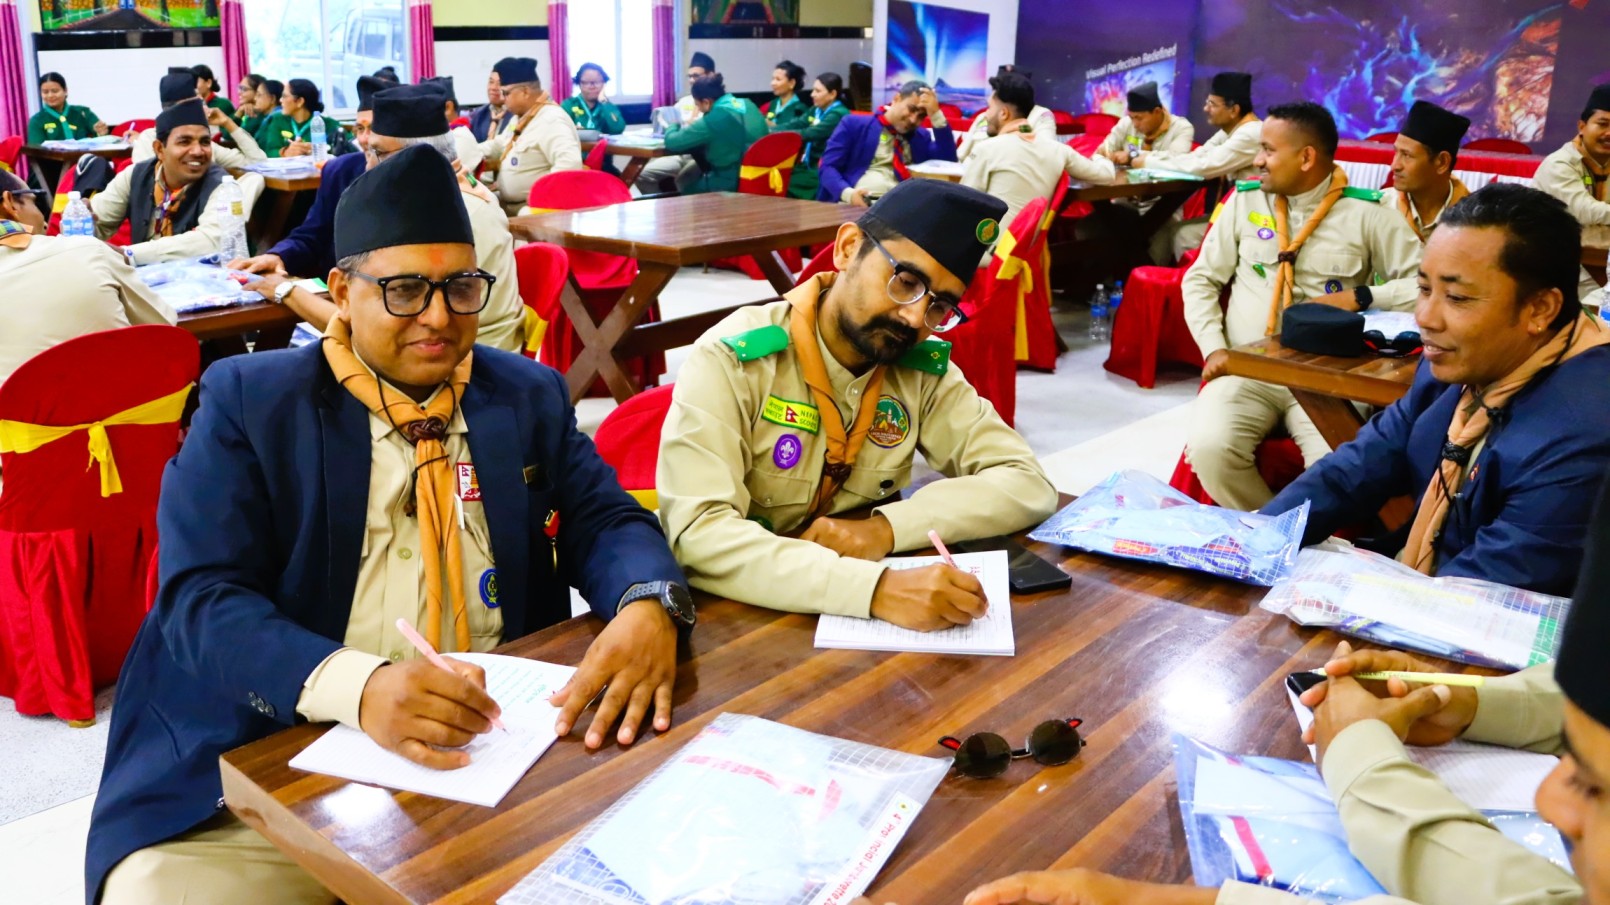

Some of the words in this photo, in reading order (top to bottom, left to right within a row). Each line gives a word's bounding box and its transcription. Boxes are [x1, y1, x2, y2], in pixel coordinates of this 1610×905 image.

[1085, 64, 1106, 79] Visual
[1107, 56, 1141, 74] Perfection
[1142, 43, 1177, 63] Redefined
